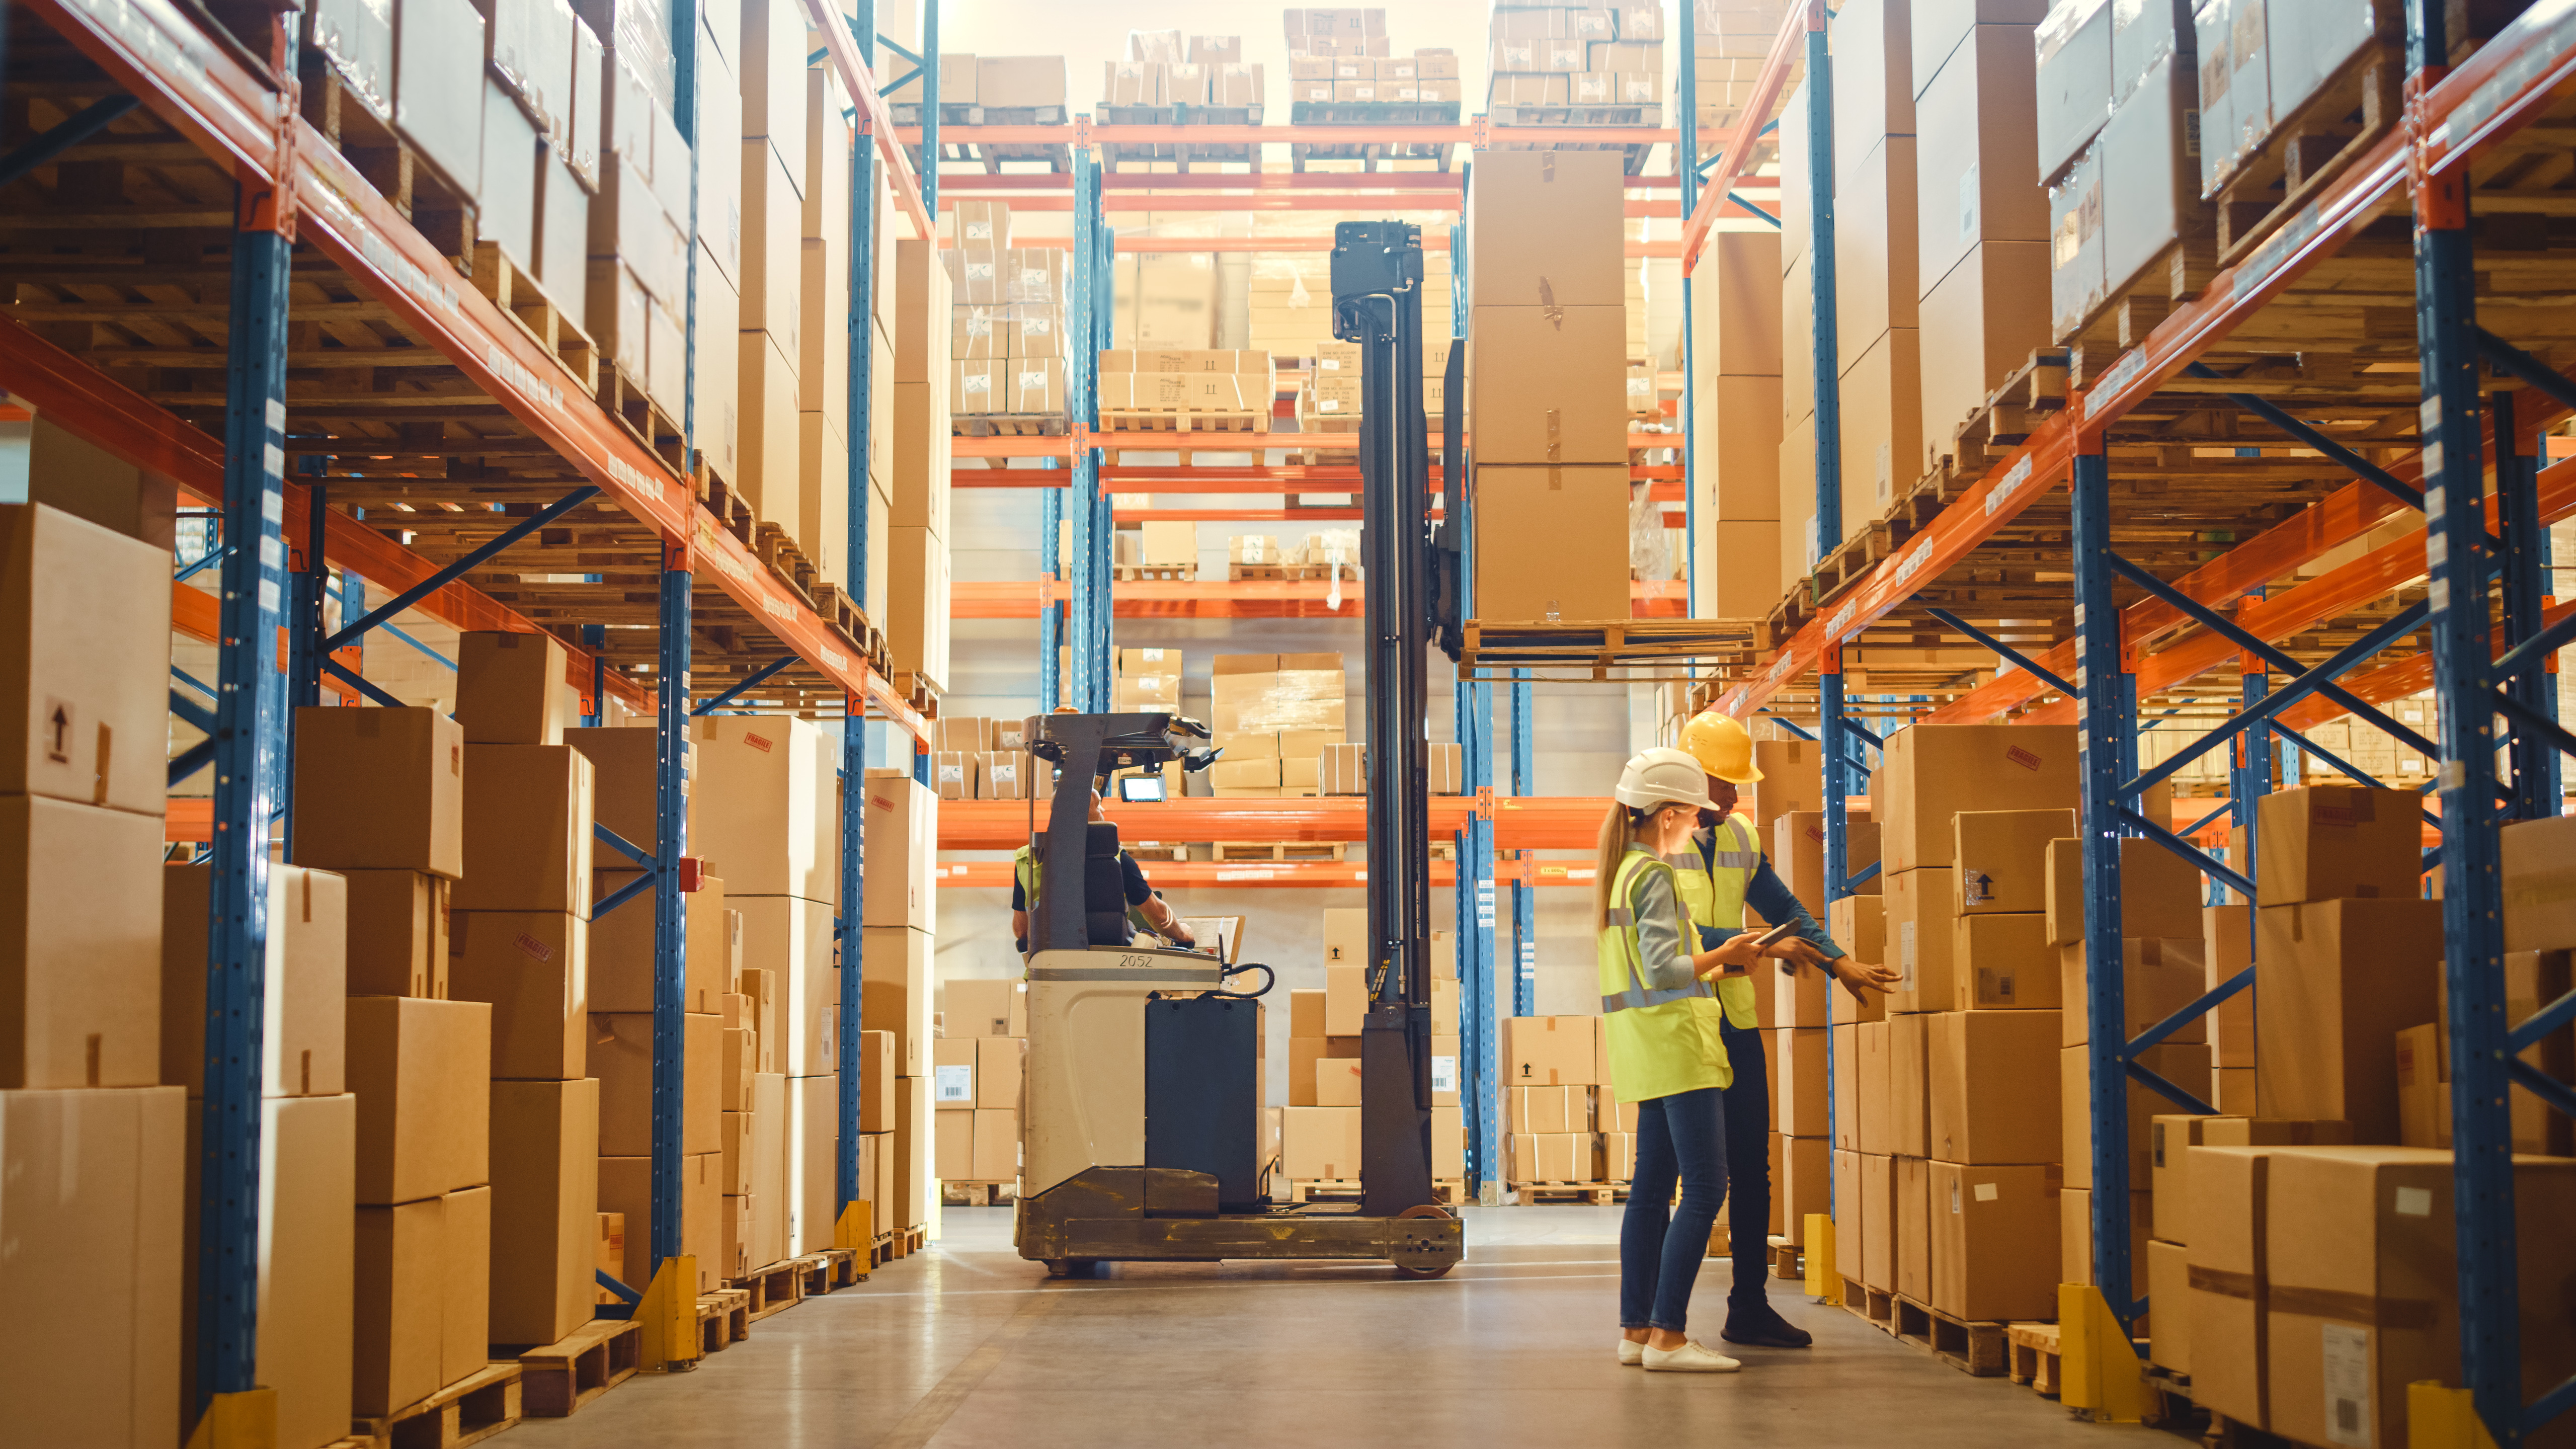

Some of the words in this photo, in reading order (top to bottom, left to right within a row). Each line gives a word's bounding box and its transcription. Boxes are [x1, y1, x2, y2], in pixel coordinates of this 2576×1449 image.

[747, 735, 770, 749] FRAGILE
[2010, 748, 2038, 766] FRAGILE
[874, 797, 892, 809] FRAGILE
[2318, 809, 2355, 821] FRAGILE
[518, 935, 550, 958] FRAGILE
[1119, 954, 1153, 968] 2052
